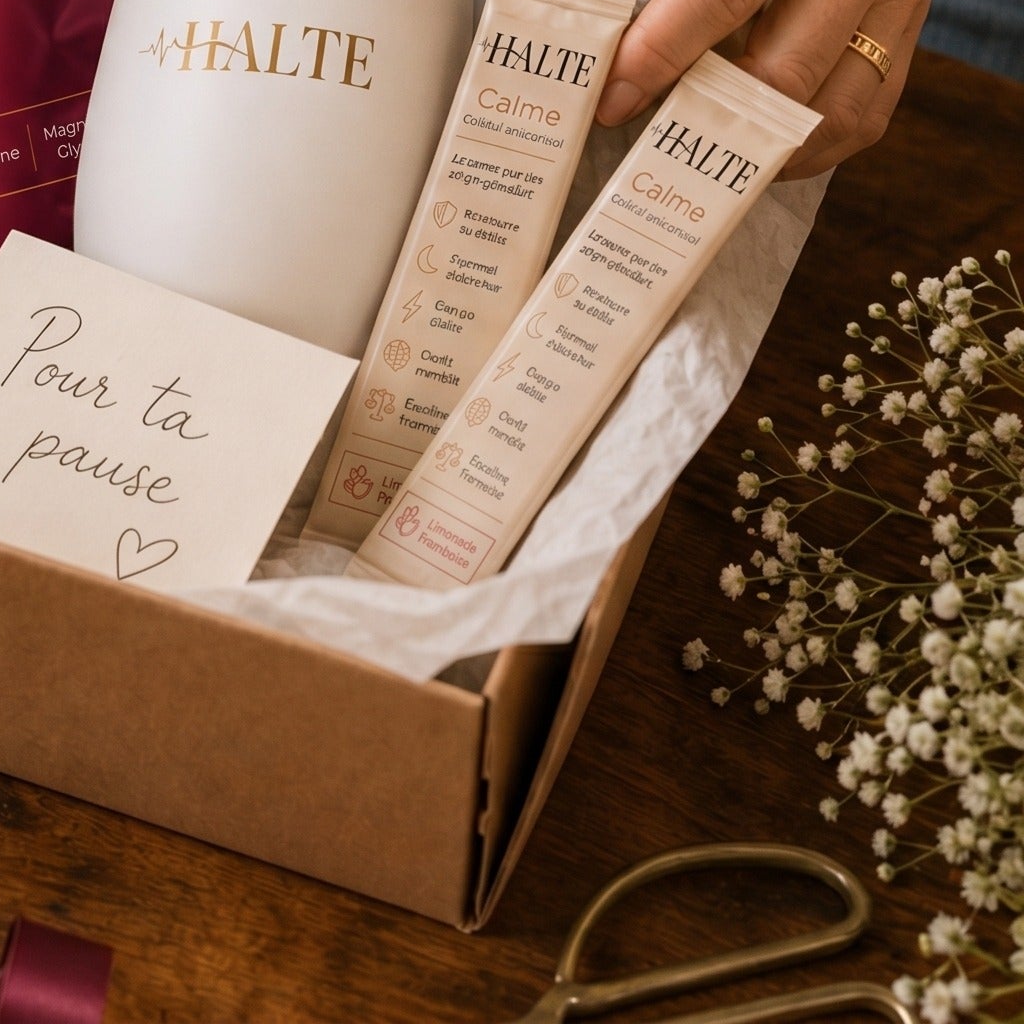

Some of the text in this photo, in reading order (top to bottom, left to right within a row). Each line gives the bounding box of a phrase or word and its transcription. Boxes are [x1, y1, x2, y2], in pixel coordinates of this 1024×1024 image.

[174, 20, 375, 90] HALTE
[484, 32, 597, 88] HALTE
[477, 87, 562, 127] Calme
[652, 120, 761, 195] HALTE
[631, 171, 705, 223] Calme
[0, 306, 209, 440] Pour ta
[1, 430, 180, 504] pause
